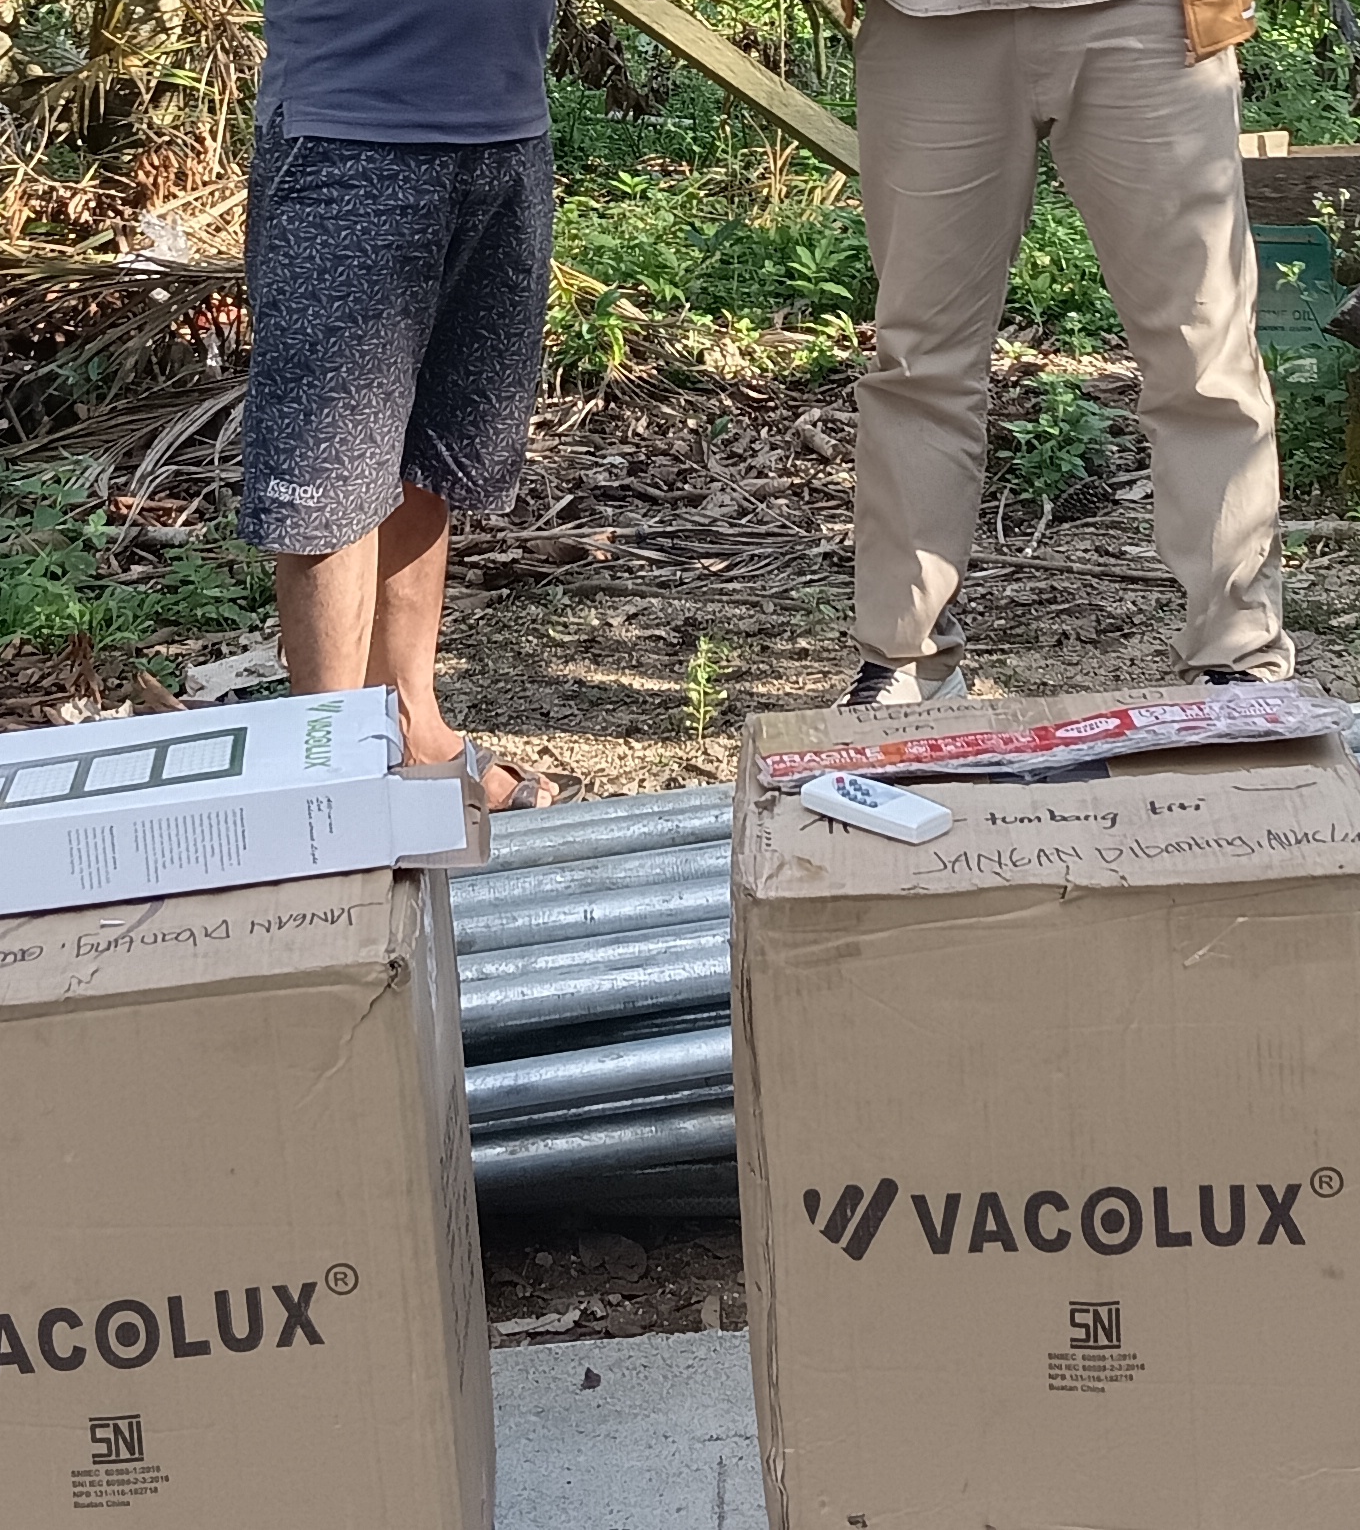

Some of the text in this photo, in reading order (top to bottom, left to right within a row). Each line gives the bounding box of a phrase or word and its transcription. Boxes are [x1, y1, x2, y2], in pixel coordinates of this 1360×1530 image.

[304, 715, 332, 769] VACOLUX
[1069, 1306, 1121, 1345] SNI
[90, 1421, 143, 1458] SNI
